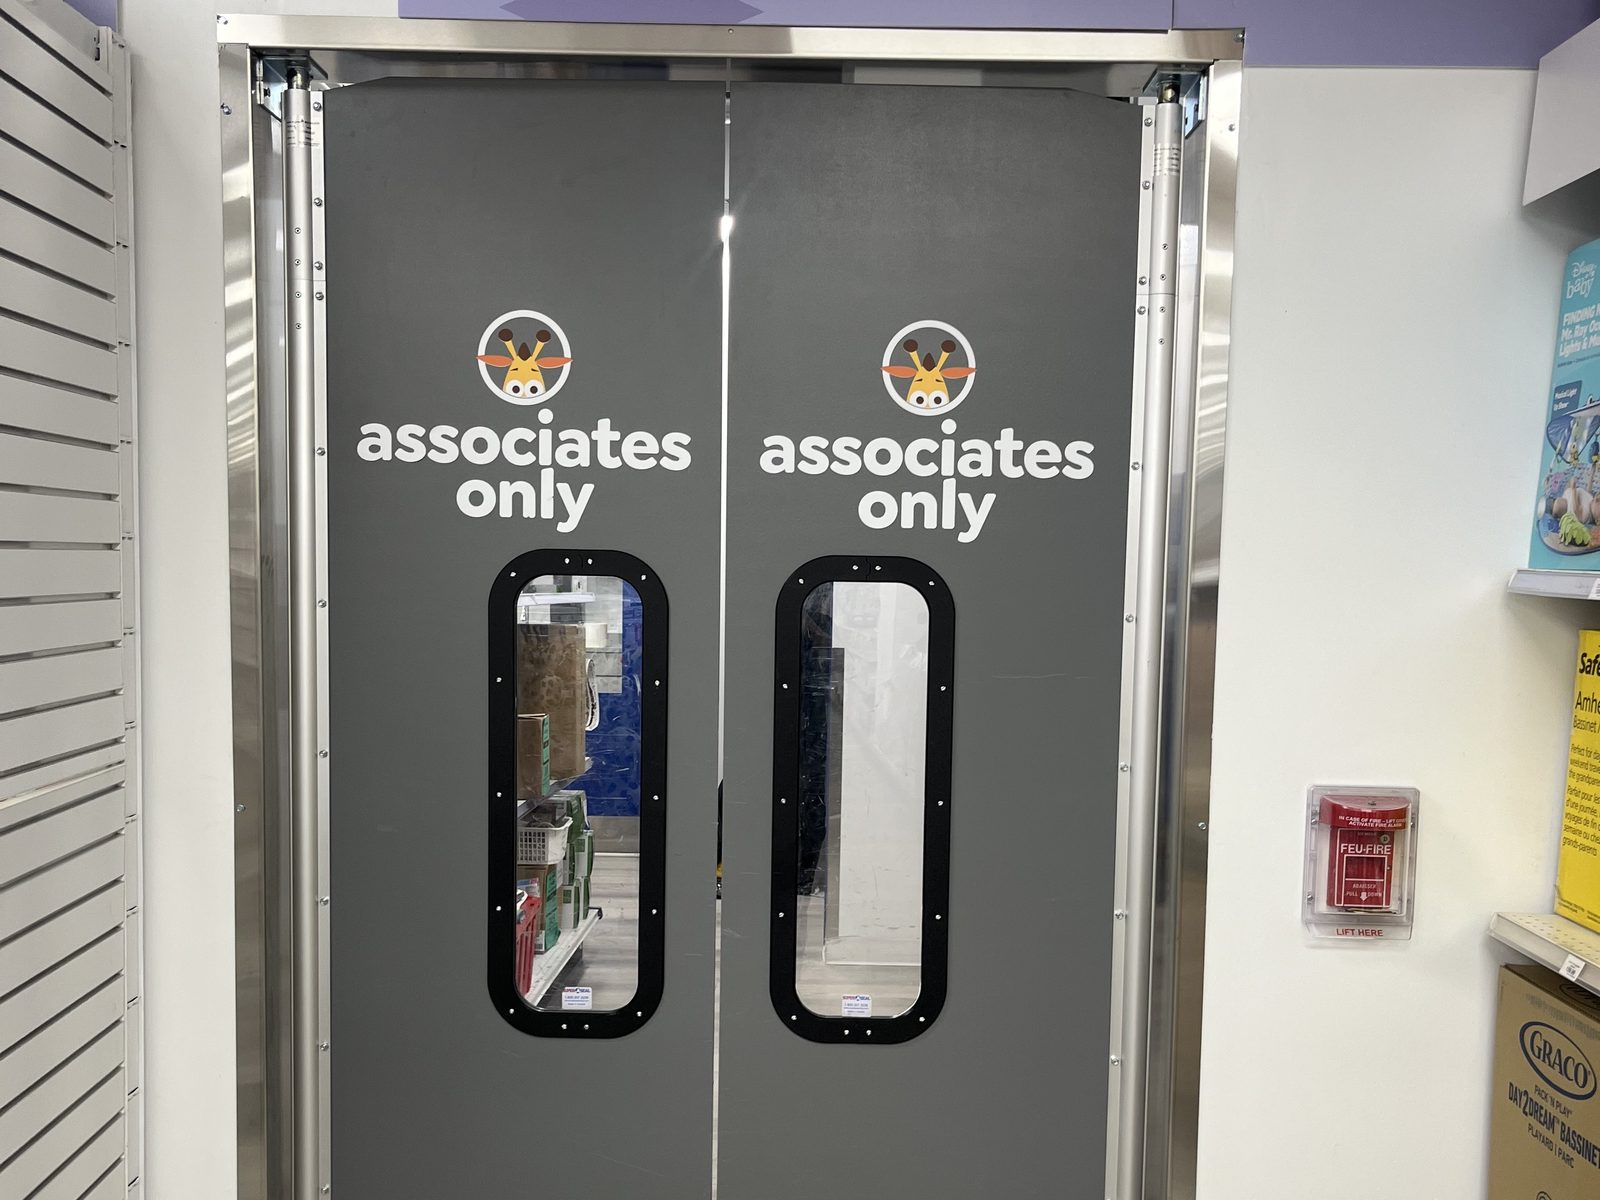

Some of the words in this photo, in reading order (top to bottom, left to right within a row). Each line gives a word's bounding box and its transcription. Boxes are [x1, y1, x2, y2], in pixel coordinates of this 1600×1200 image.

[1566, 278, 1595, 299] baby
[1563, 304, 1595, 326] FINDING
[1559, 340, 1581, 358] Lights
[356, 408, 692, 471] associates
[759, 418, 1095, 480] associates
[456, 467, 595, 533] only
[857, 477, 997, 543] only
[1573, 715, 1597, 733] Bassinet
[1336, 928, 1355, 936] LIFT
[1358, 929, 1384, 937] HERE
[1529, 1030, 1588, 1089] GRACO
[1534, 1084, 1548, 1104] PACK
[1555, 1100, 1571, 1118] PLAY
[1528, 1122, 1554, 1152] PLAYARD
[1557, 1147, 1574, 1168] PARC
